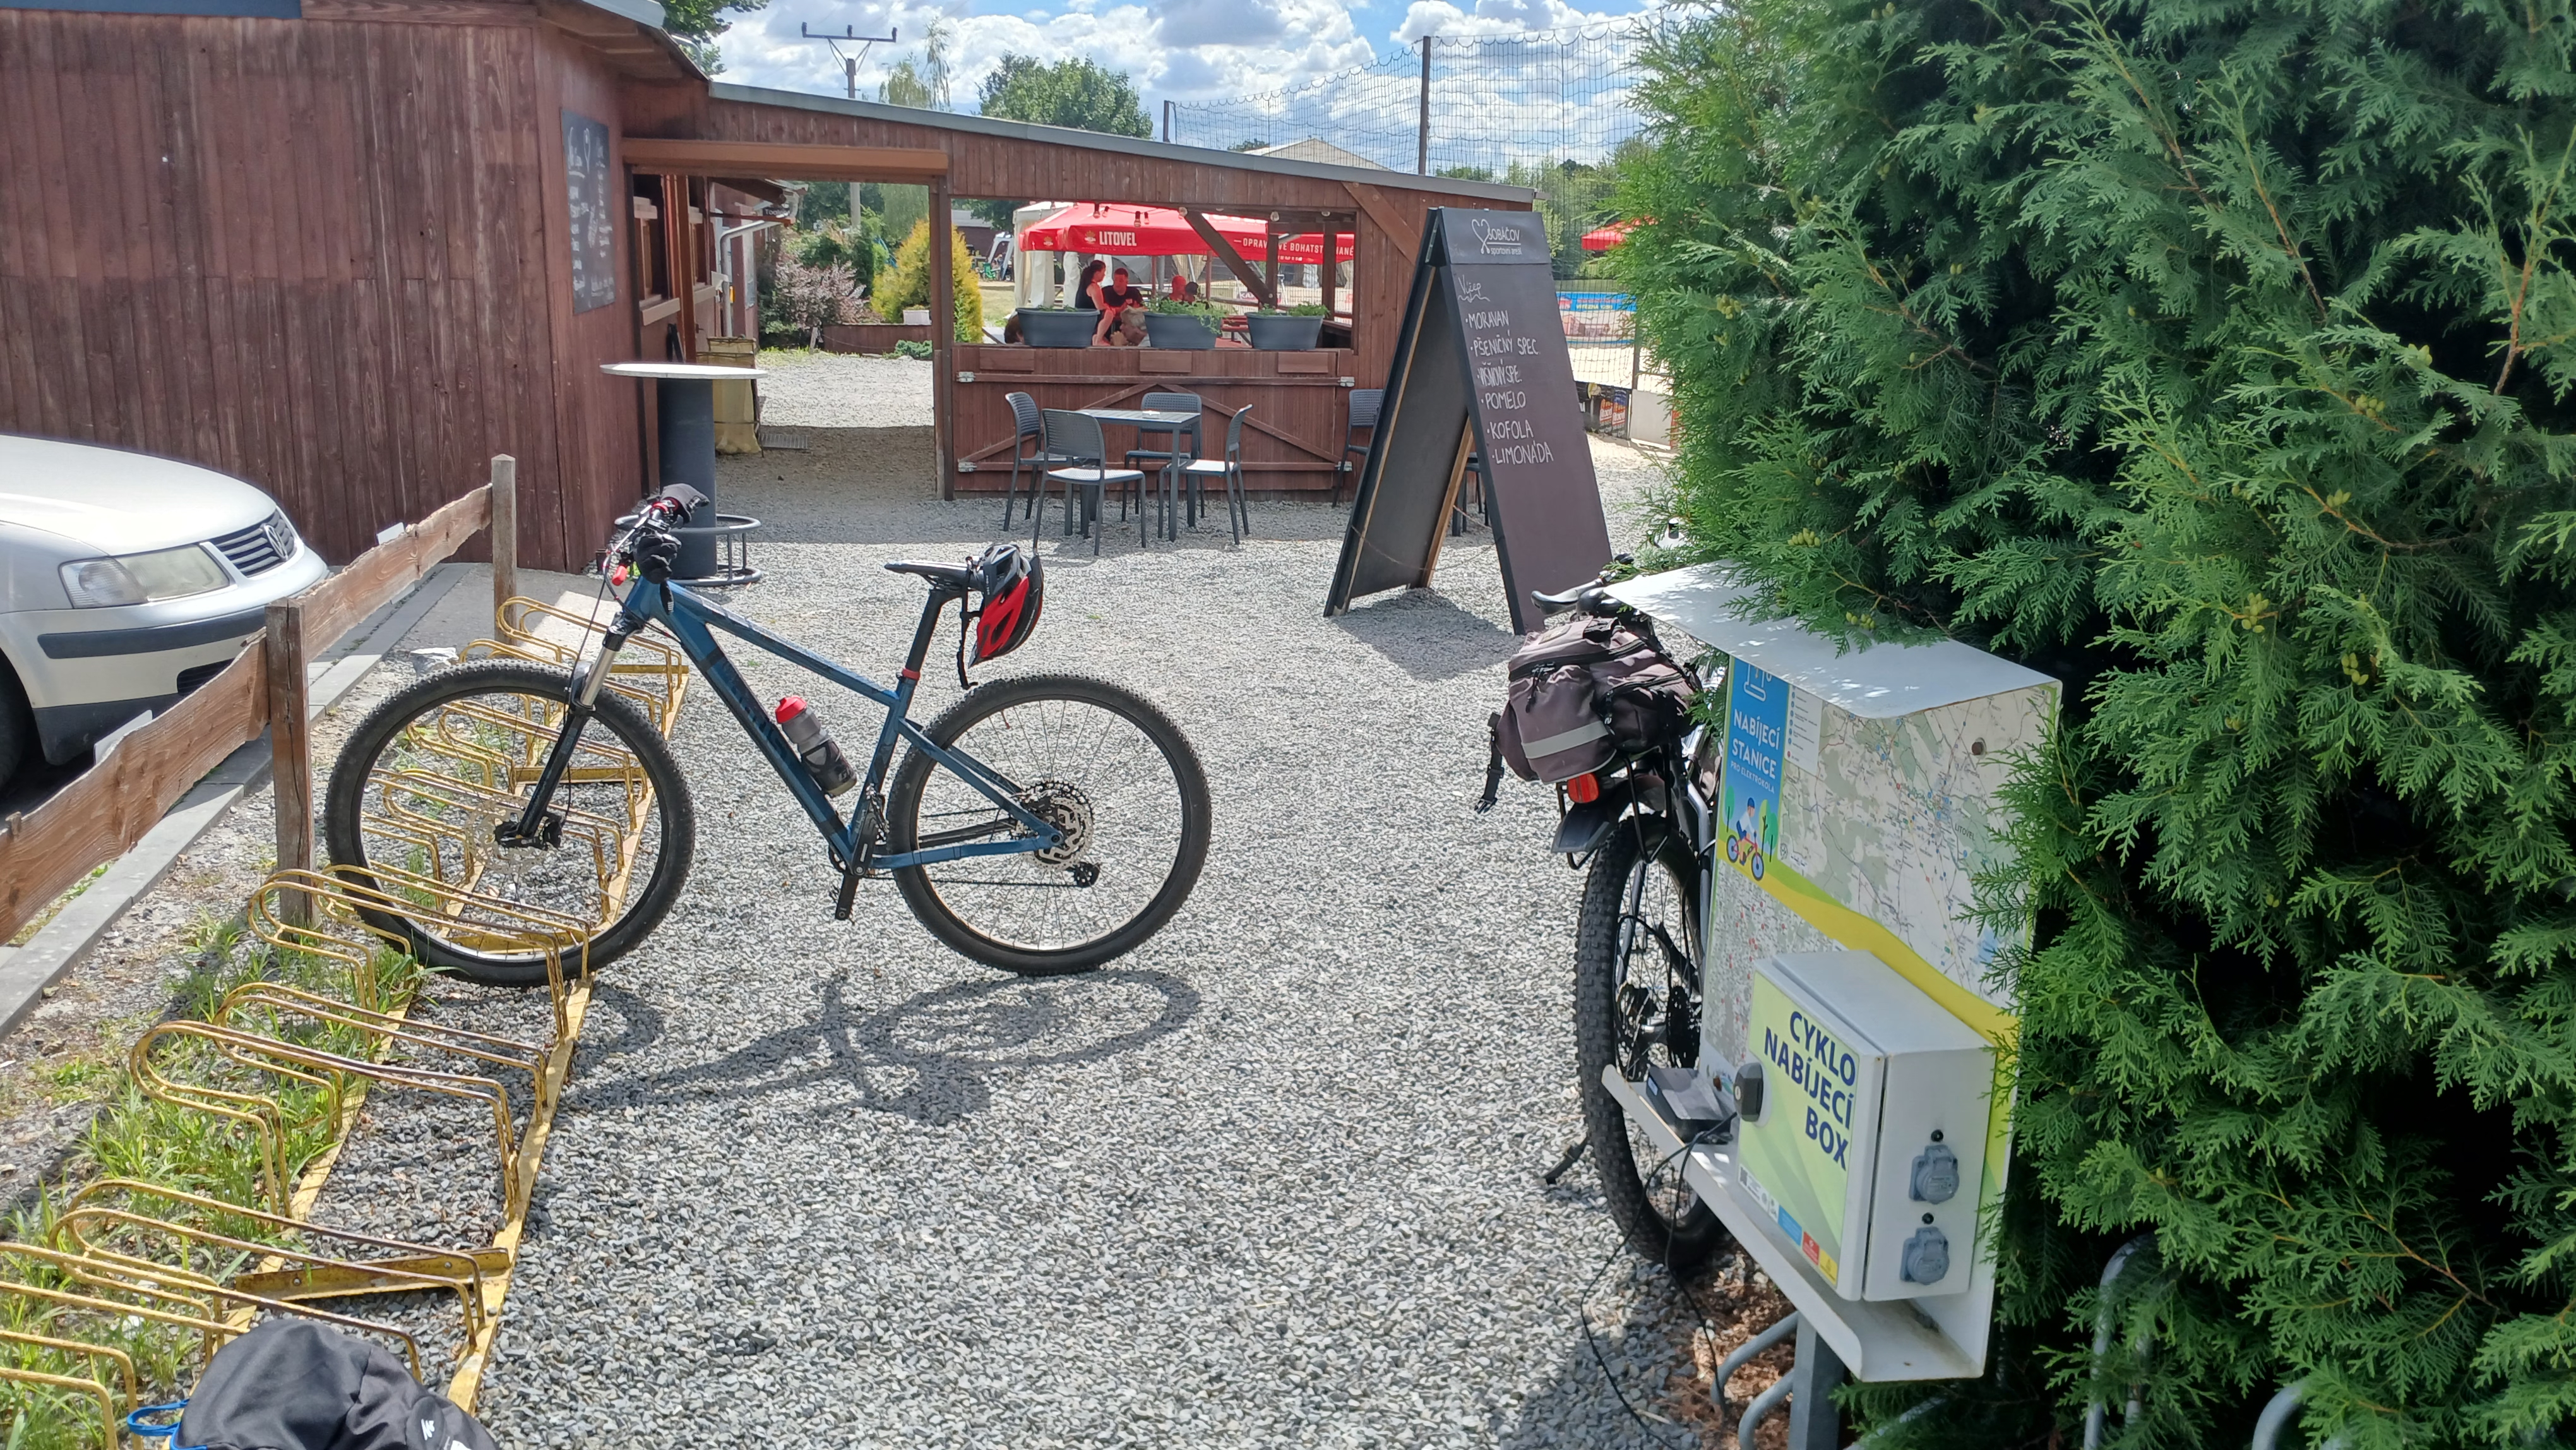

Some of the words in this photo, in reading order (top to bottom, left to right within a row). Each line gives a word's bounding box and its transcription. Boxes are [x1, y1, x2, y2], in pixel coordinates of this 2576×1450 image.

[1099, 231, 1137, 247] LITOVEL
[1468, 310, 1510, 330] MORAVAN
[1485, 390, 1526, 410] POMELO
[1489, 419, 1534, 440] KOFOLA
[1494, 440, 1554, 465] LIMONÁDA
[1734, 709, 1780, 750] NABÍJECÍ
[1732, 738, 1777, 779] STANICE
[1730, 760, 1741, 772] PRO
[1741, 767, 1775, 794] ELEKTROKOLA
[1955, 823, 1976, 841] LITOVEL
[1790, 1010, 1856, 1086] CYKLO
[1764, 1026, 1854, 1130] NABÍJECÍ
[1805, 1105, 1849, 1172] BOX
